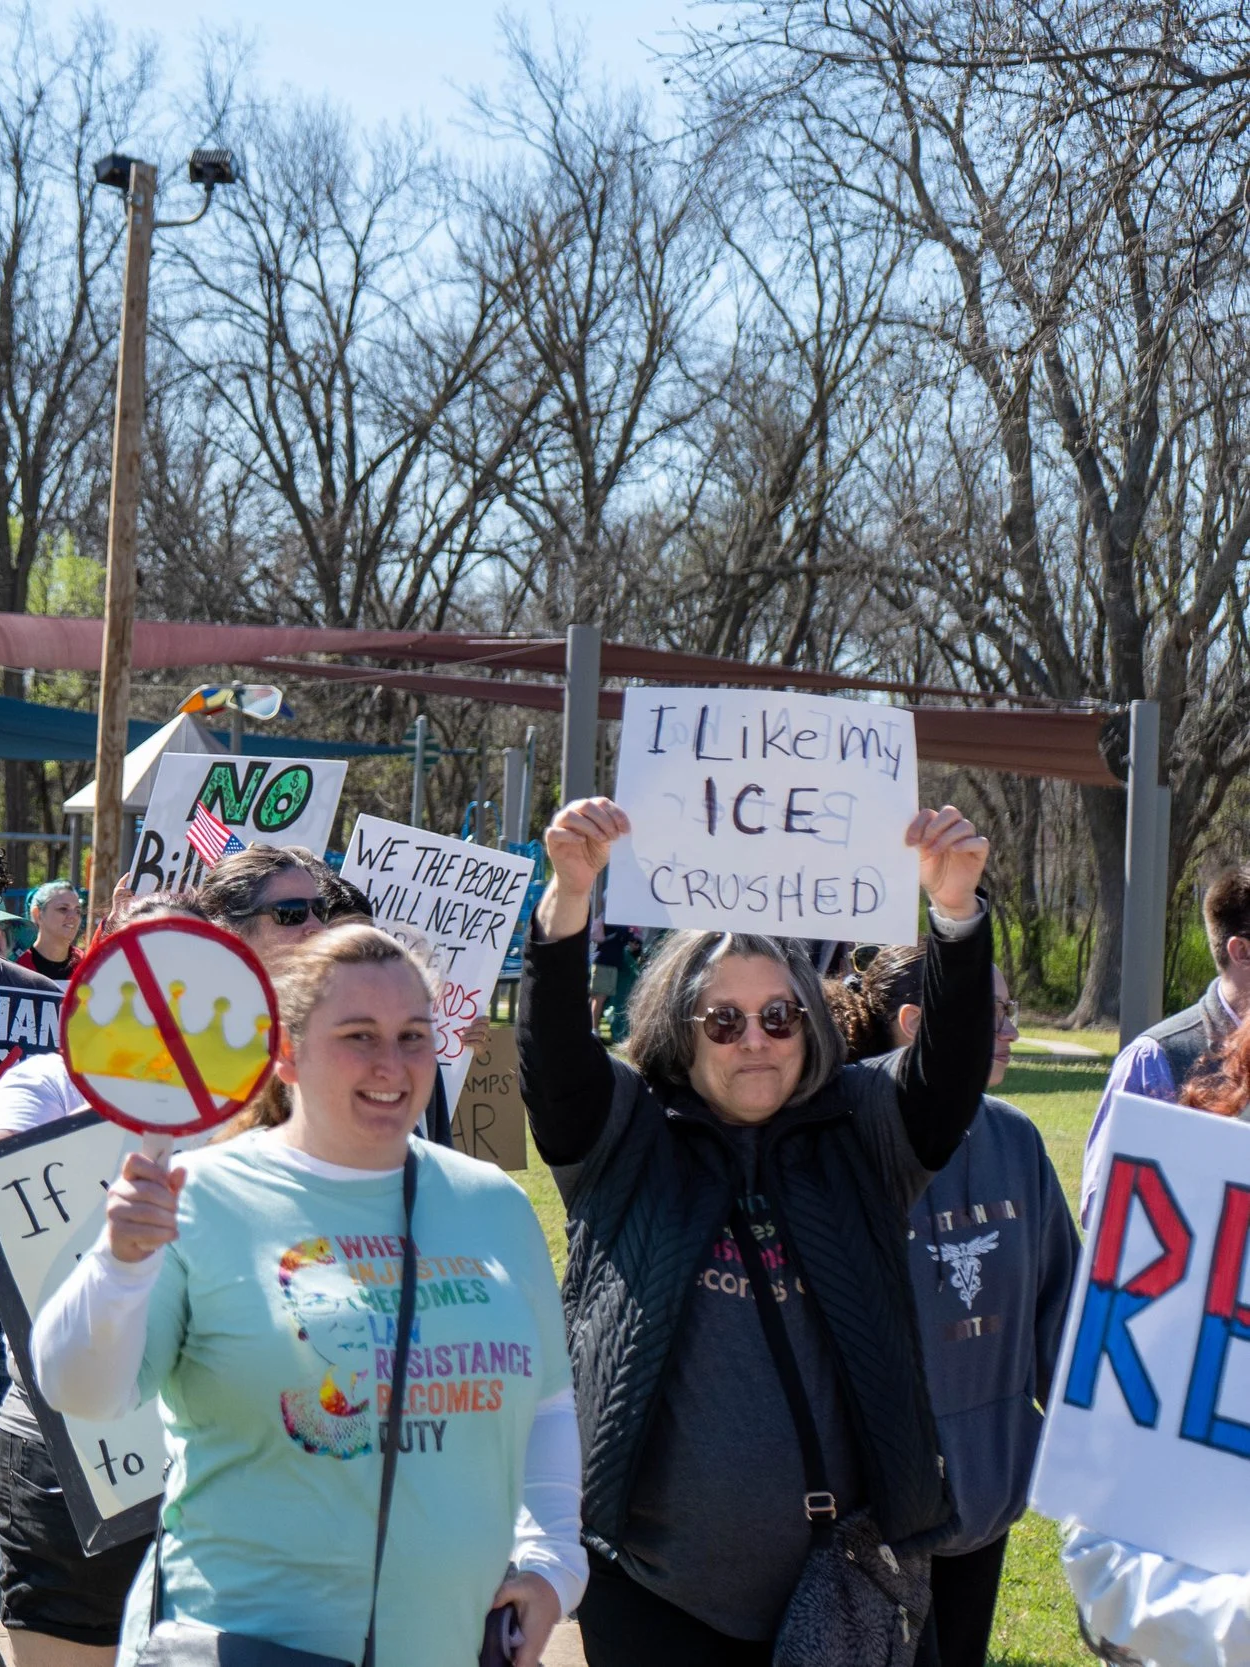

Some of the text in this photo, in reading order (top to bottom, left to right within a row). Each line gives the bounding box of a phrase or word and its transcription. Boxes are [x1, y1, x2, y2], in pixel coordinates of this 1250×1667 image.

[647, 704, 677, 755] I
[186, 761, 313, 833] NO
[705, 776, 821, 837] ICE
[357, 829, 528, 907] WE THE PEOPLE
[651, 866, 880, 923] CRUSHED
[425, 896, 507, 950] NEVER
[1, 1160, 73, 1240] If
[374, 1342, 534, 1381] RSISTANCE
[377, 1379, 505, 1416] BCOMES
[94, 1438, 146, 1486] to
